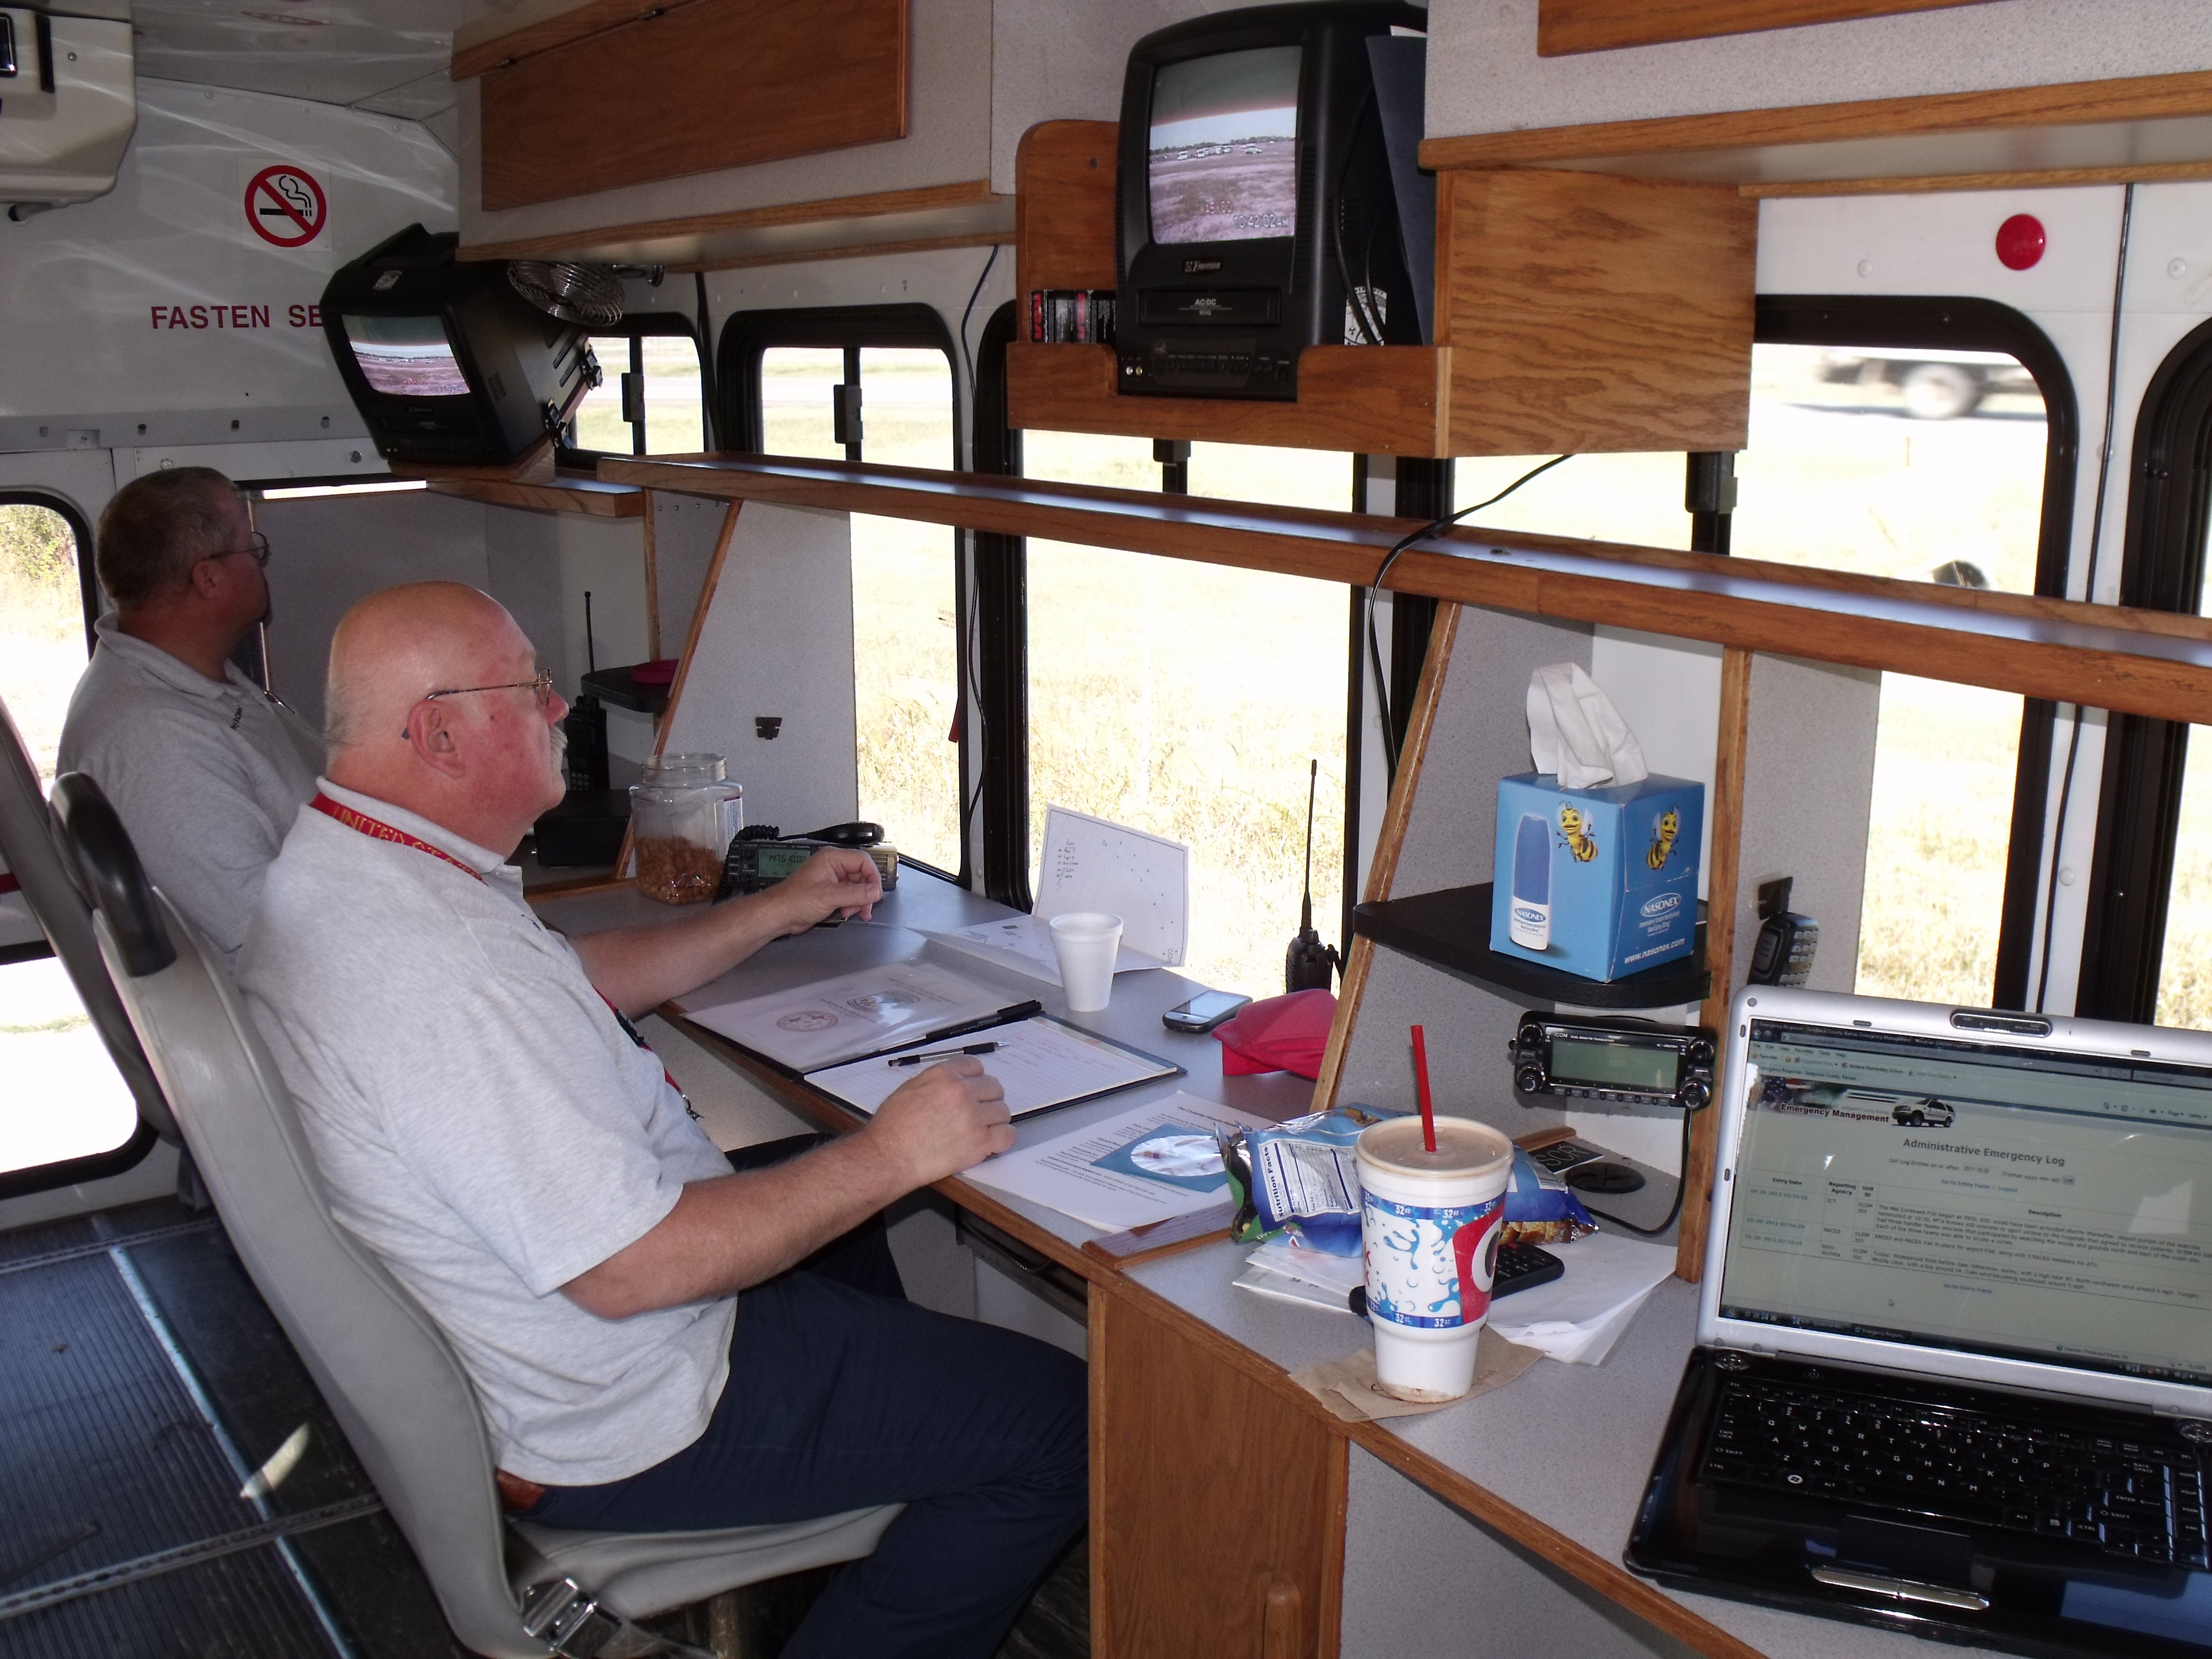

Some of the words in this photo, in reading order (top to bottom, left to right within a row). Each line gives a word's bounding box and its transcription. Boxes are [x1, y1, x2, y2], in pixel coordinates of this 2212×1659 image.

[151, 304, 271, 330] FASTEN
[1516, 910, 1544, 922] NASONEX
[1643, 897, 1680, 913] NASONEX
[1624, 938, 1685, 964] www.nasonex.com
[1780, 1104, 1829, 1116] Emergency
[1832, 1109, 1889, 1122] Management
[1264, 1146, 1273, 1174] Facts
[1534, 1144, 1589, 1166] SCR
[1903, 1139, 1980, 1155] Administrative
[1983, 1148, 2042, 1164] Emergency
[2045, 1155, 2065, 1167] Log
[1828, 1181, 1856, 1190] Reporting
[1271, 1176, 1284, 1218] Nutrition
[2028, 1209, 2062, 1218] Description
